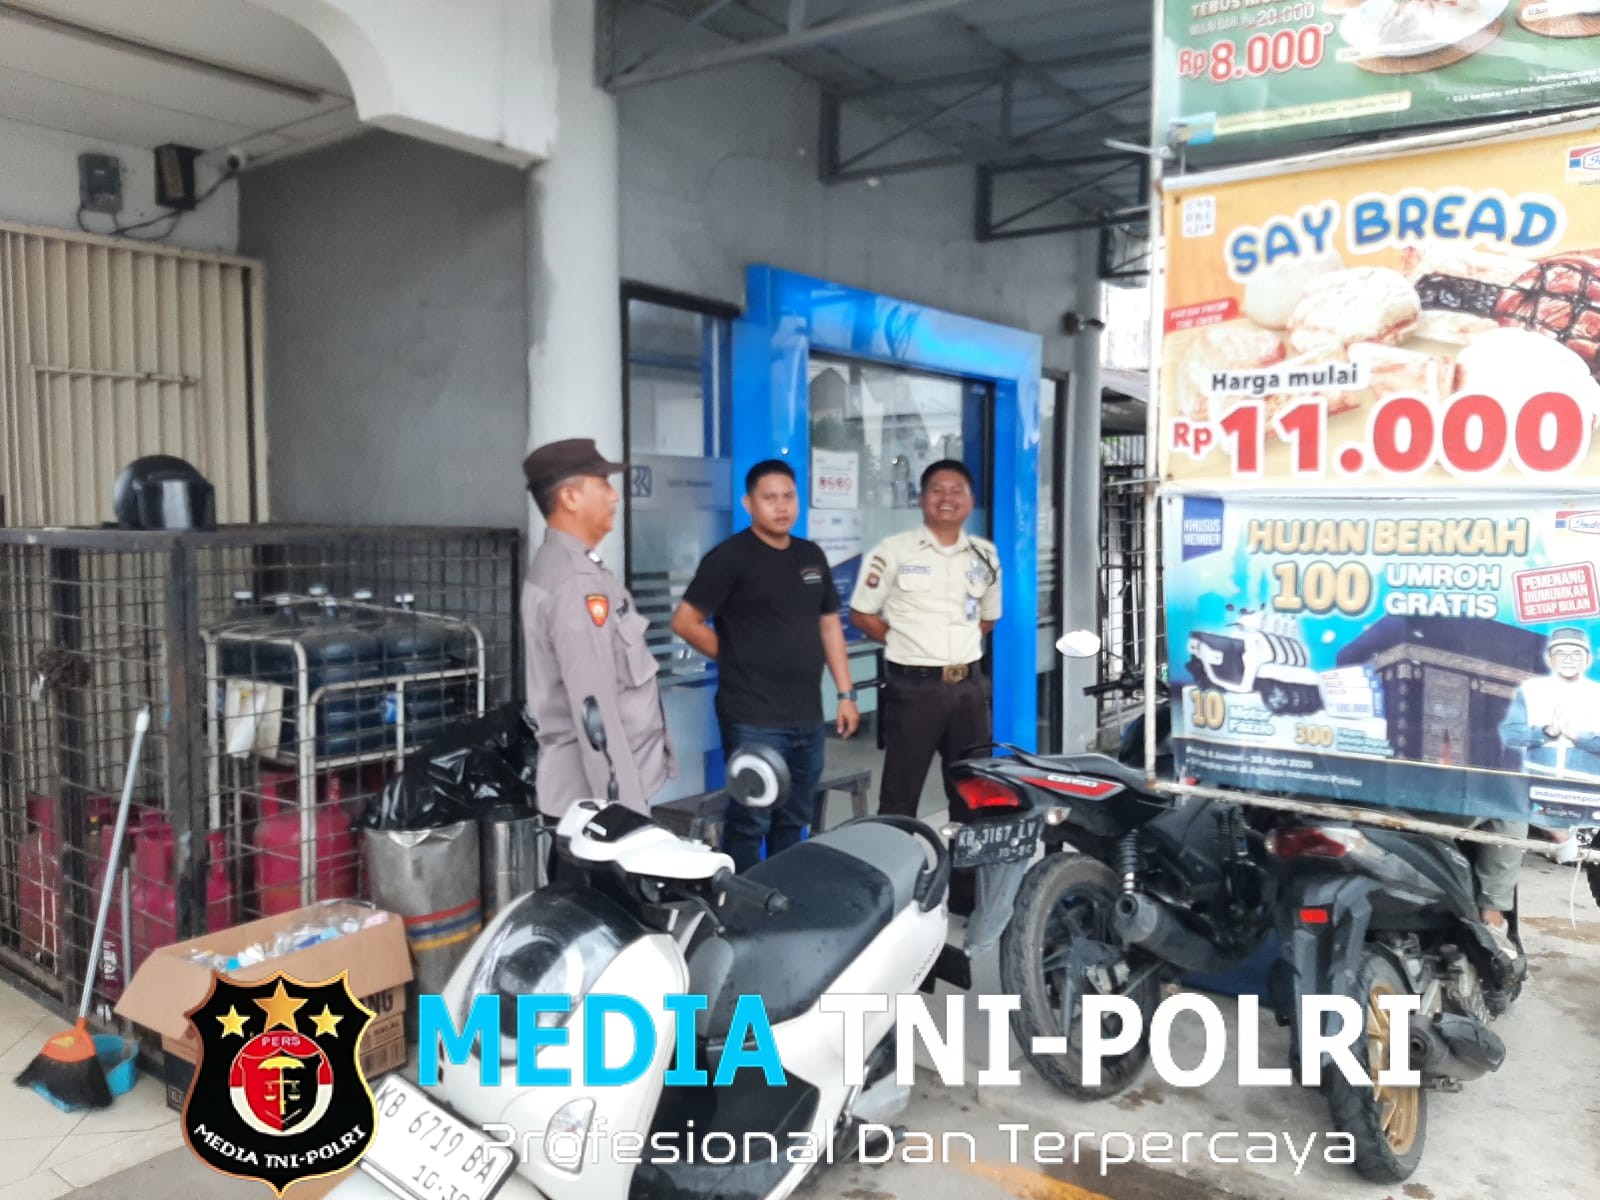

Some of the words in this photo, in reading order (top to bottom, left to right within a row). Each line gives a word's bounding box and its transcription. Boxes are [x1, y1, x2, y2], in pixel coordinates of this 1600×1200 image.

[1179, 49, 1207, 78] Rp
[1231, 206, 1333, 275] SAY
[1354, 194, 1558, 248] BREAD
[1211, 371, 1279, 395] Harga
[1289, 364, 1358, 387] mulai
[1173, 422, 1212, 454] Rp
[1220, 391, 1584, 473] 11.000
[1248, 518, 1368, 555] HUJAN
[1372, 517, 1529, 557] BERKAH
[1272, 560, 1373, 616] 100
[1384, 562, 1502, 591] UMROH
[1520, 569, 1587, 591] PEMENANG
[1384, 591, 1499, 619] GRATIS
[1190, 689, 1225, 730] 10
[1295, 724, 1334, 747] 300
[408, 1109, 465, 1158] 6719
